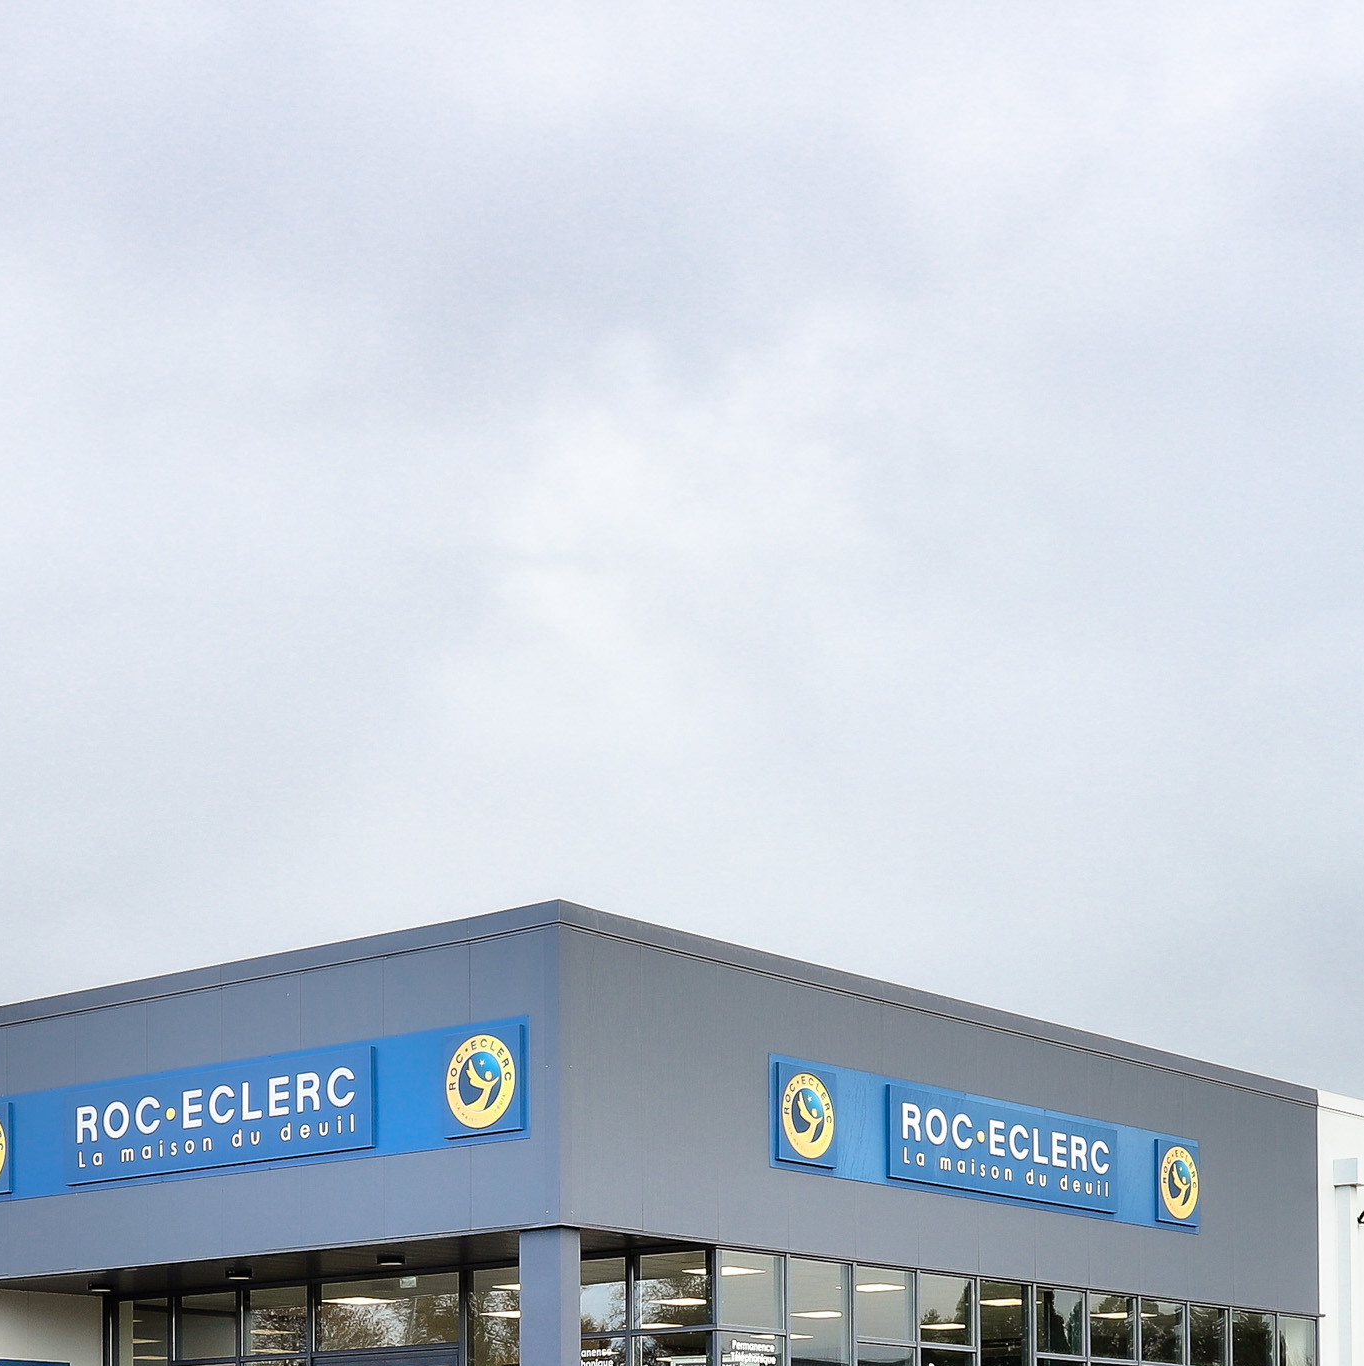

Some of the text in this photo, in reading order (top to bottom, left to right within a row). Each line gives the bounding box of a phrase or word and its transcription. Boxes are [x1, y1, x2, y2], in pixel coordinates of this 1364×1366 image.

[78, 1113, 355, 1168] La maison du deuil
[903, 1146, 1109, 1197] La maison du deuil
[581, 1349, 612, 1358] anence
[731, 1339, 775, 1352] Permanence
